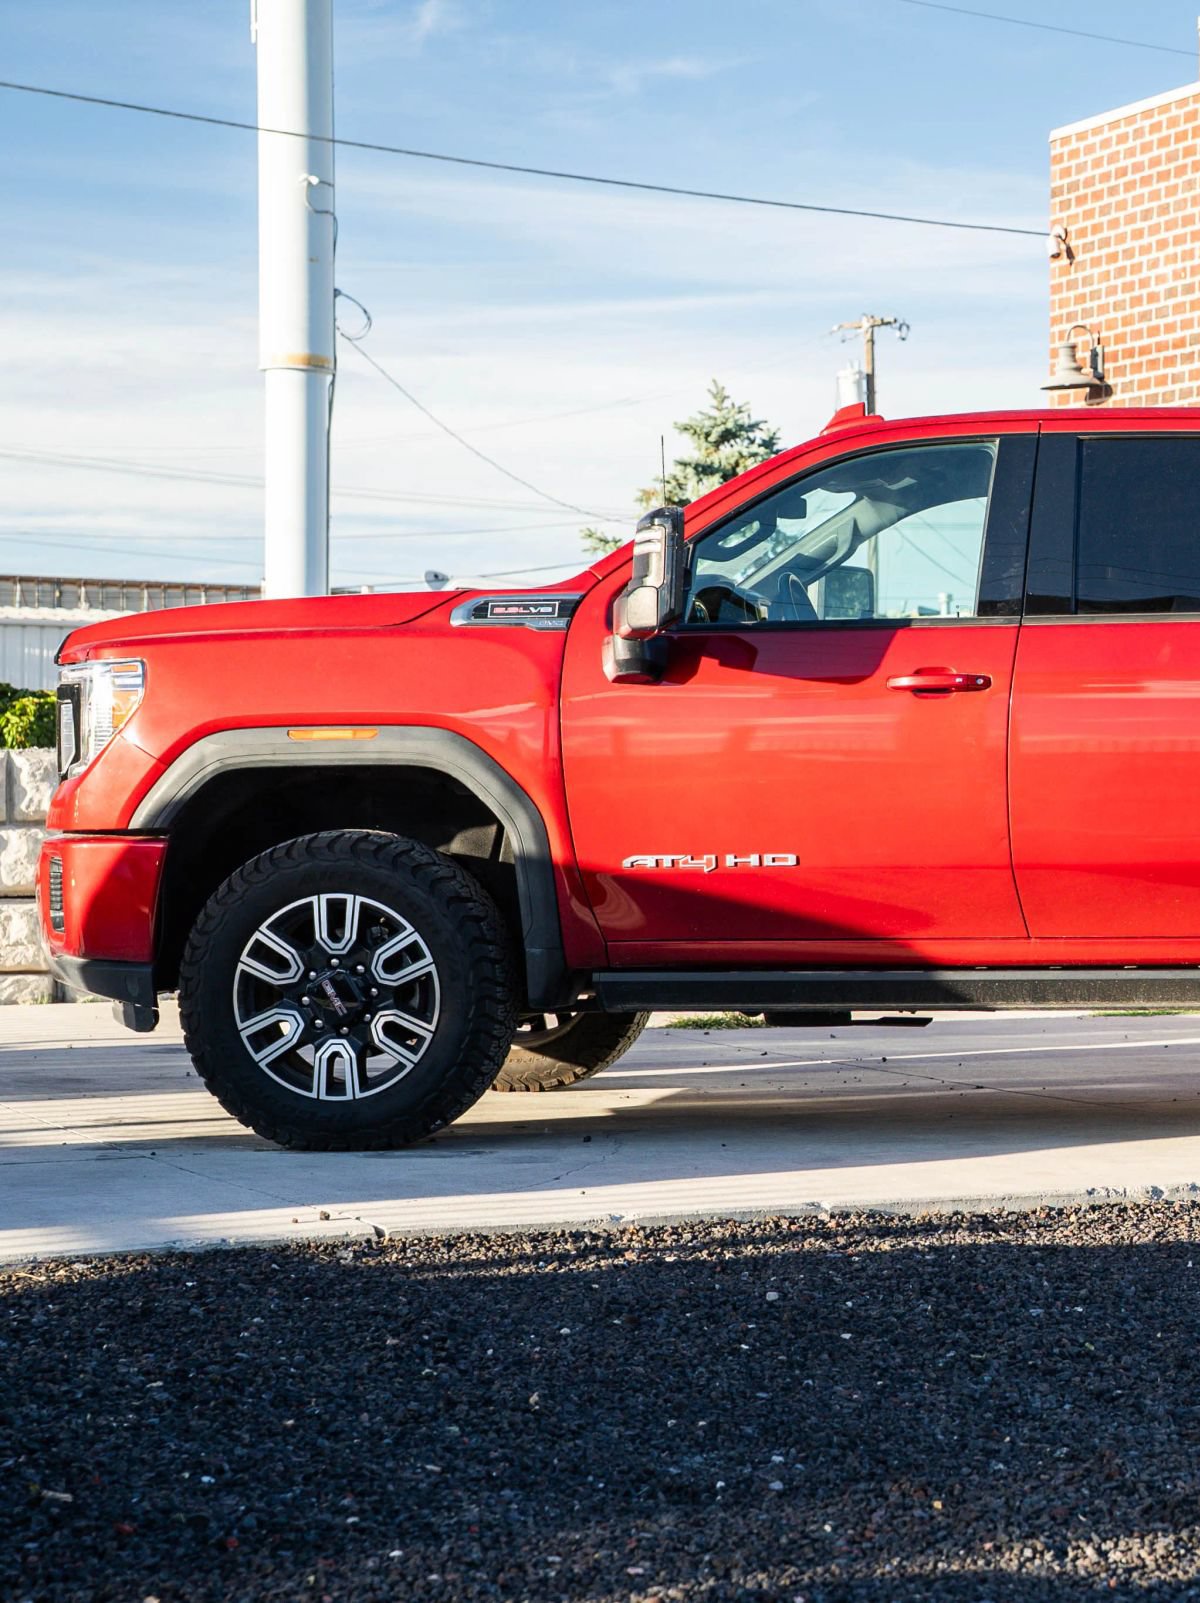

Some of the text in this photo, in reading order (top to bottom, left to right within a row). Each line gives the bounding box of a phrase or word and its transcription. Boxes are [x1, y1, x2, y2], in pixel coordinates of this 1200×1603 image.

[622, 853, 799, 873] AT4 HD
[321, 979, 348, 1017] GMC
